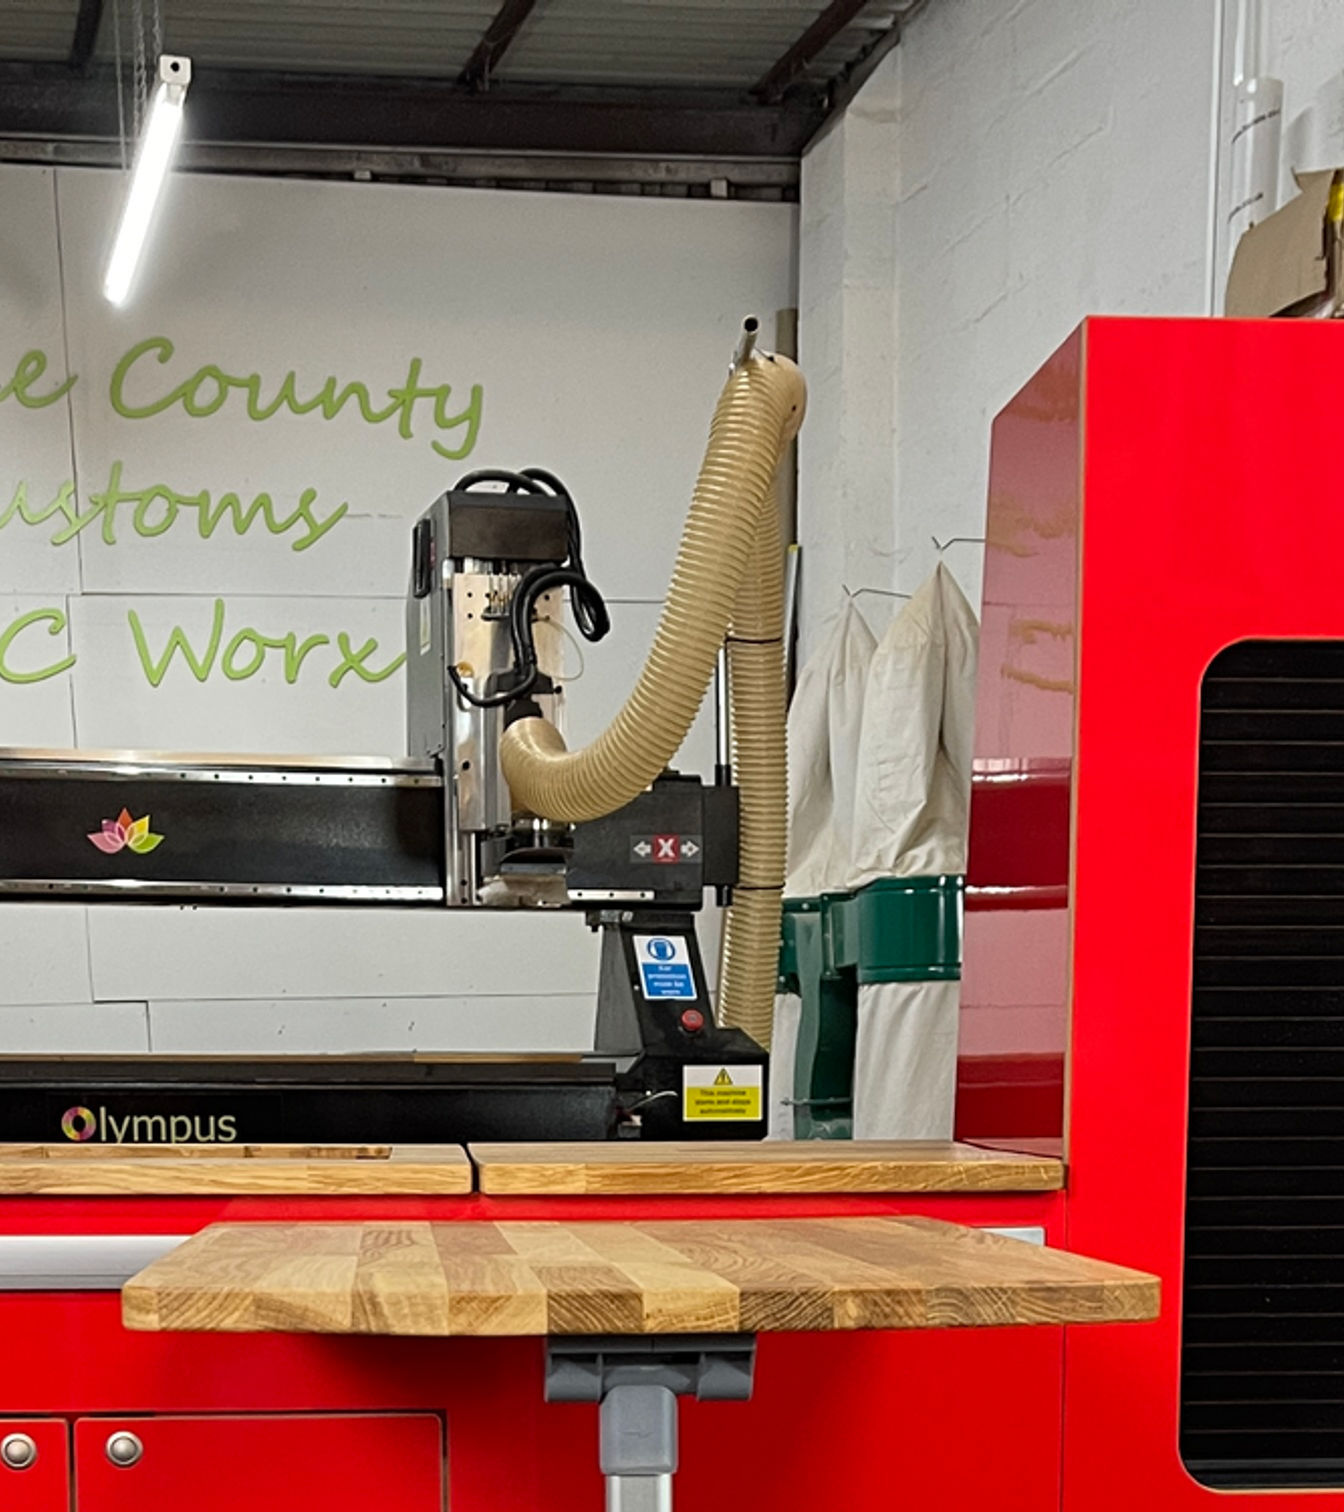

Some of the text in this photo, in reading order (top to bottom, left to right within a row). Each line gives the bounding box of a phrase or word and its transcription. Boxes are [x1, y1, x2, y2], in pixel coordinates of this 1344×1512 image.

[110, 337, 483, 461] County
[126, 597, 408, 689] Worx
[657, 837, 676, 858] X
[60, 1105, 238, 1144] Olympus
